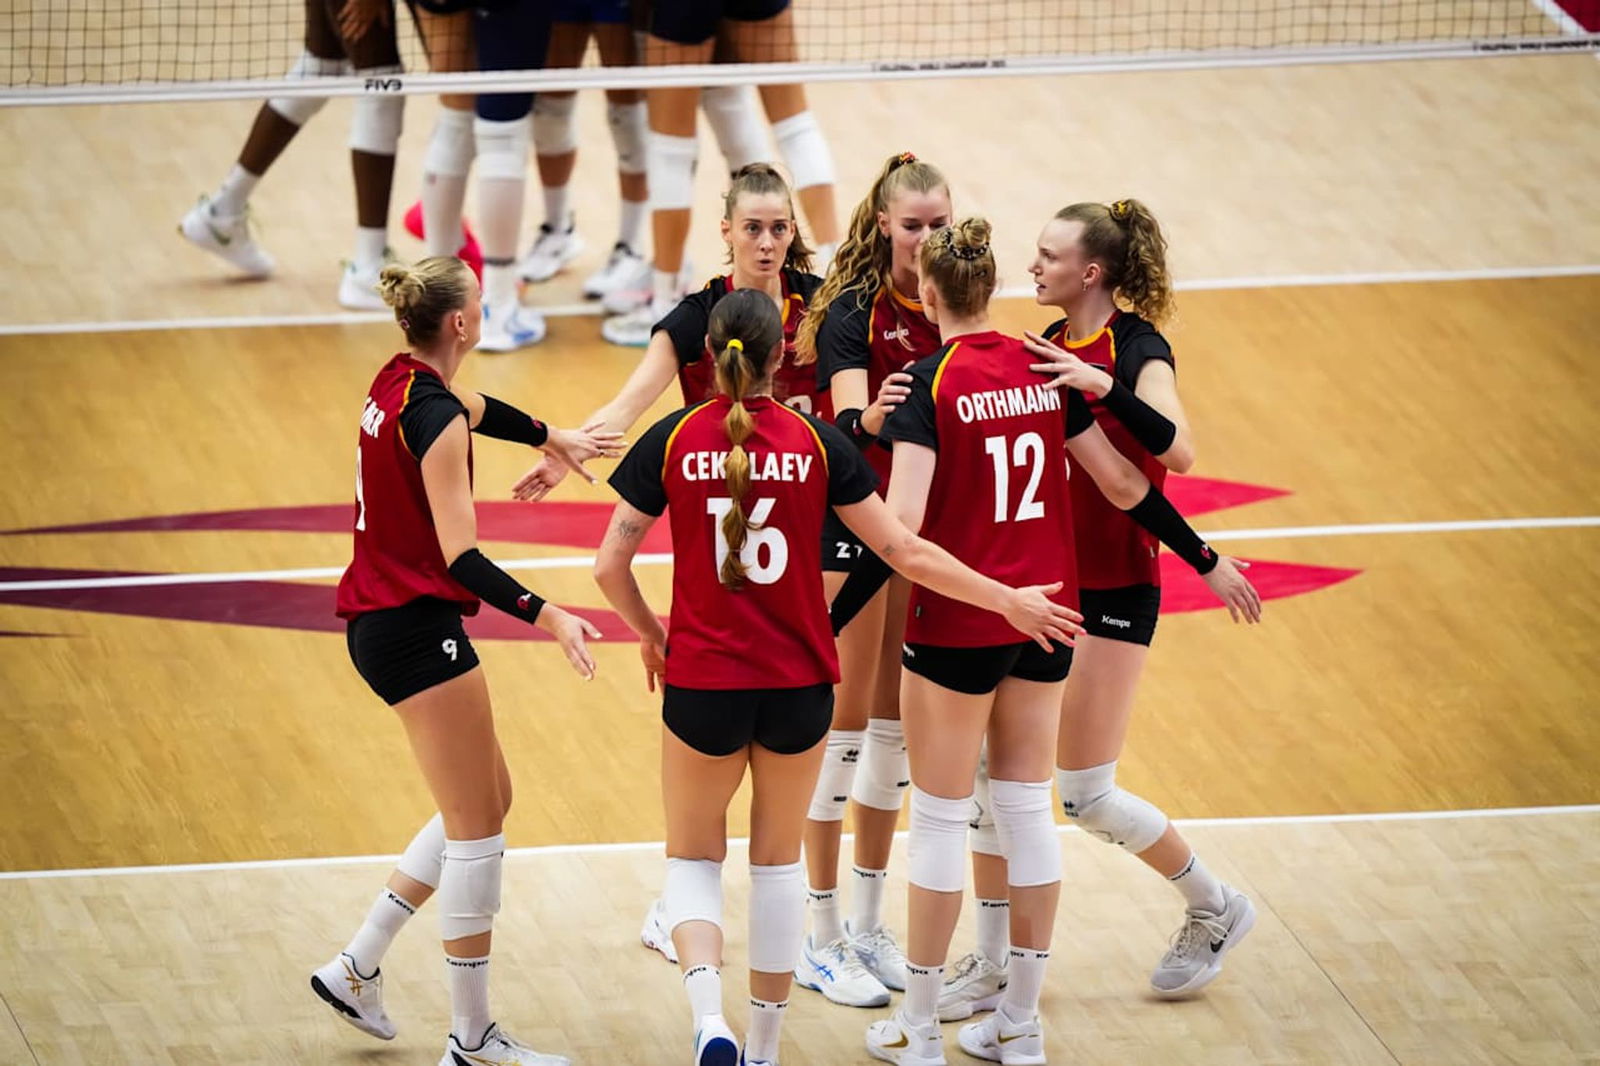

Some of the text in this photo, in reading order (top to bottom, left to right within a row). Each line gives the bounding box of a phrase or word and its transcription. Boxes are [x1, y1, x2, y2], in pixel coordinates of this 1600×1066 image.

[956, 384, 1061, 424] ORTHMANN
[682, 451, 813, 483] CEKLAEV
[985, 431, 1045, 523] 12
[707, 497, 789, 585] 16
[1102, 615, 1131, 629] Kempa
[442, 638, 457, 661] 9
